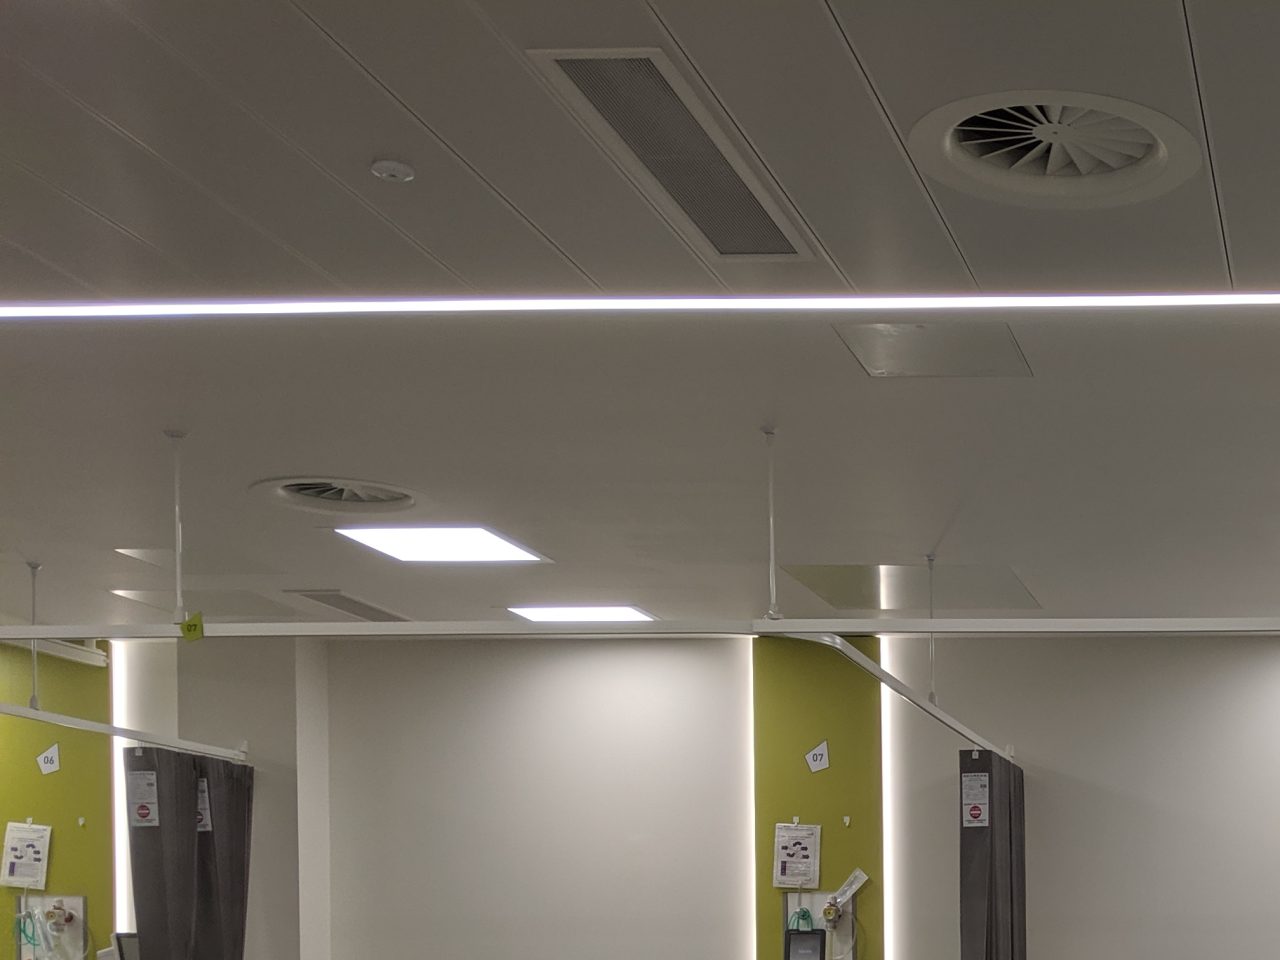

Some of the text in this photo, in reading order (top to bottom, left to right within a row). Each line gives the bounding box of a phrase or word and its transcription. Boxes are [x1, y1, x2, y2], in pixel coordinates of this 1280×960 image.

[187, 623, 198, 632] 07
[43, 755, 55, 765] 06
[812, 753, 824, 762] 07
